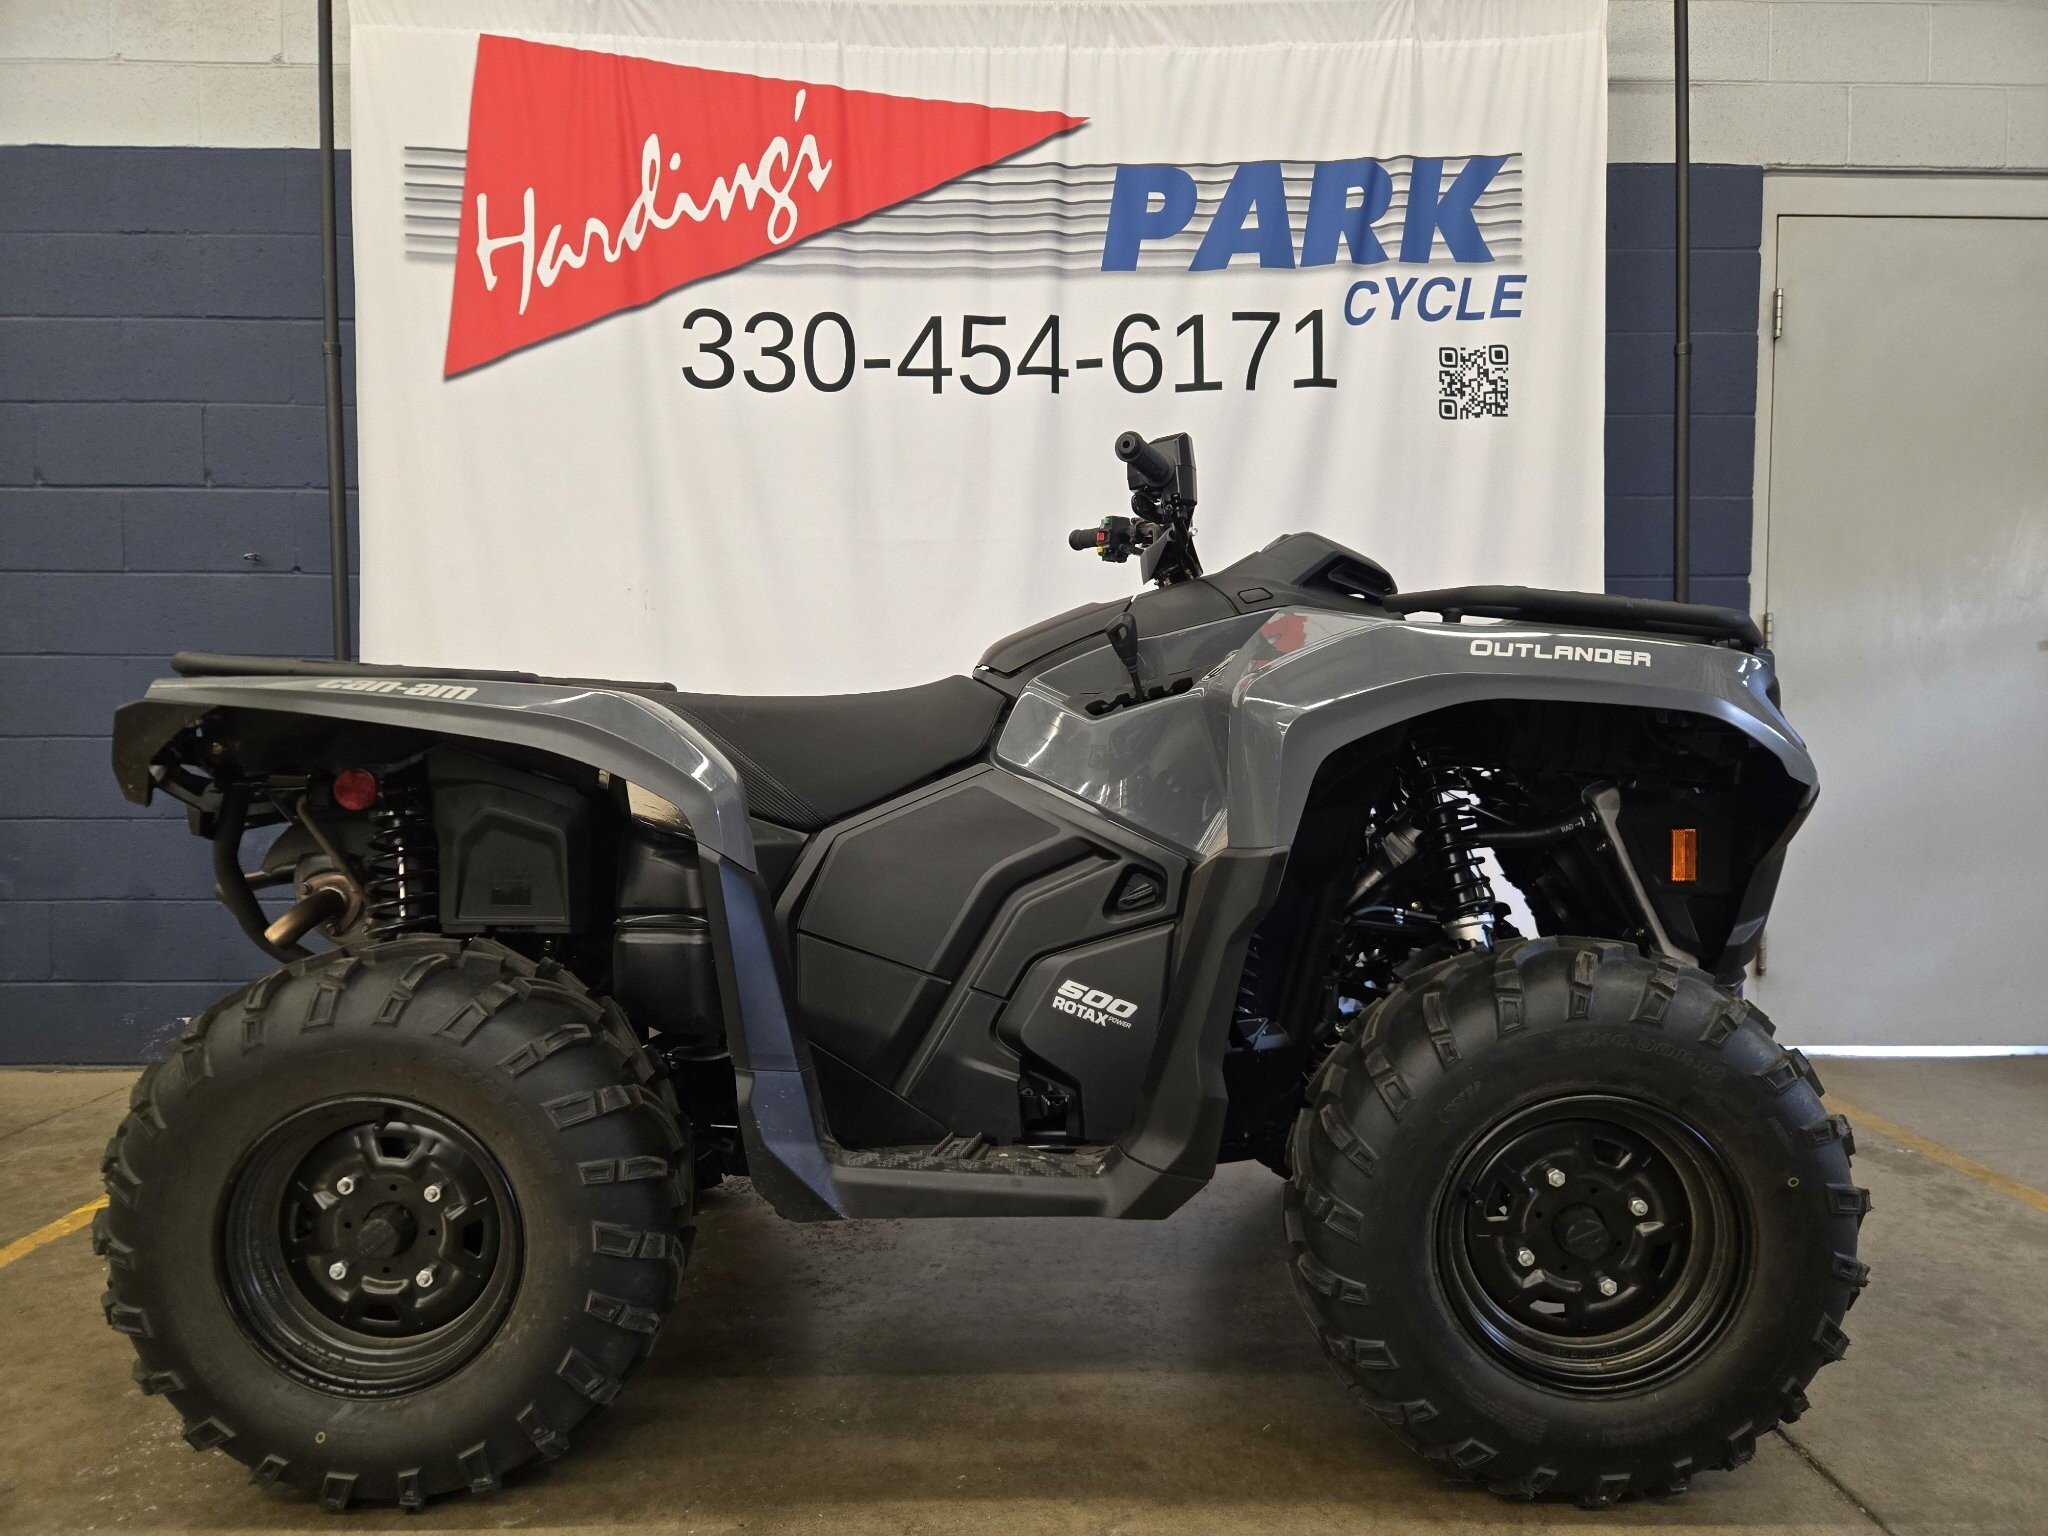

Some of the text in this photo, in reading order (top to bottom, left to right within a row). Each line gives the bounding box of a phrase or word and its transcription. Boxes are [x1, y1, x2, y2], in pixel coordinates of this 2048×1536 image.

[475, 89, 832, 316] Harding's
[1100, 155, 1509, 272] PARK
[1343, 274, 1528, 326] CYCLE
[681, 308, 1338, 395] 330-454-6171
[1469, 639, 1652, 667] OUTLANDER
[316, 679, 479, 700] can-am
[1052, 995, 1132, 1029] ROTAX POWER
[1057, 979, 1139, 1019] 500
